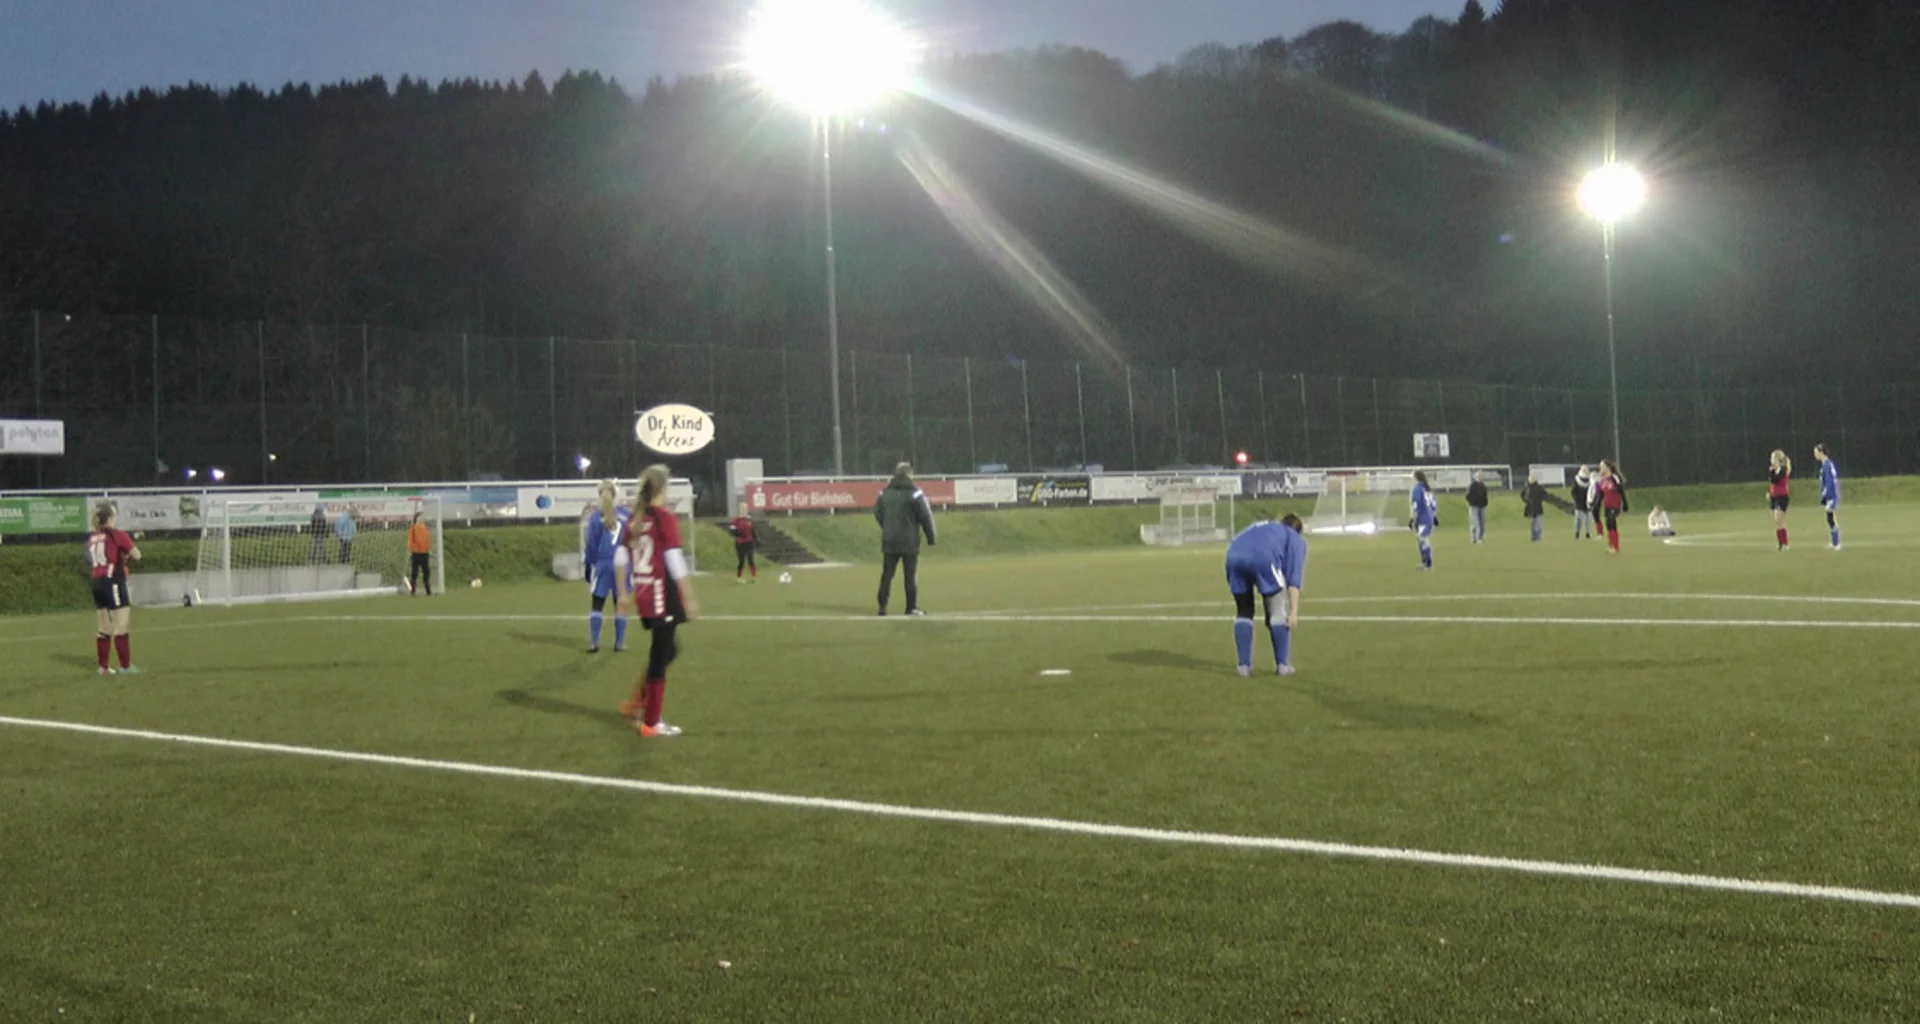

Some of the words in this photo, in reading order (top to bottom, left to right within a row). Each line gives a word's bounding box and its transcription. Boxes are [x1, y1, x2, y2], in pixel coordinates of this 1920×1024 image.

[647, 415, 666, 432] Dr.
[671, 414, 703, 431] Kind
[772, 492, 792, 506] Gut
[793, 491, 809, 506] für
